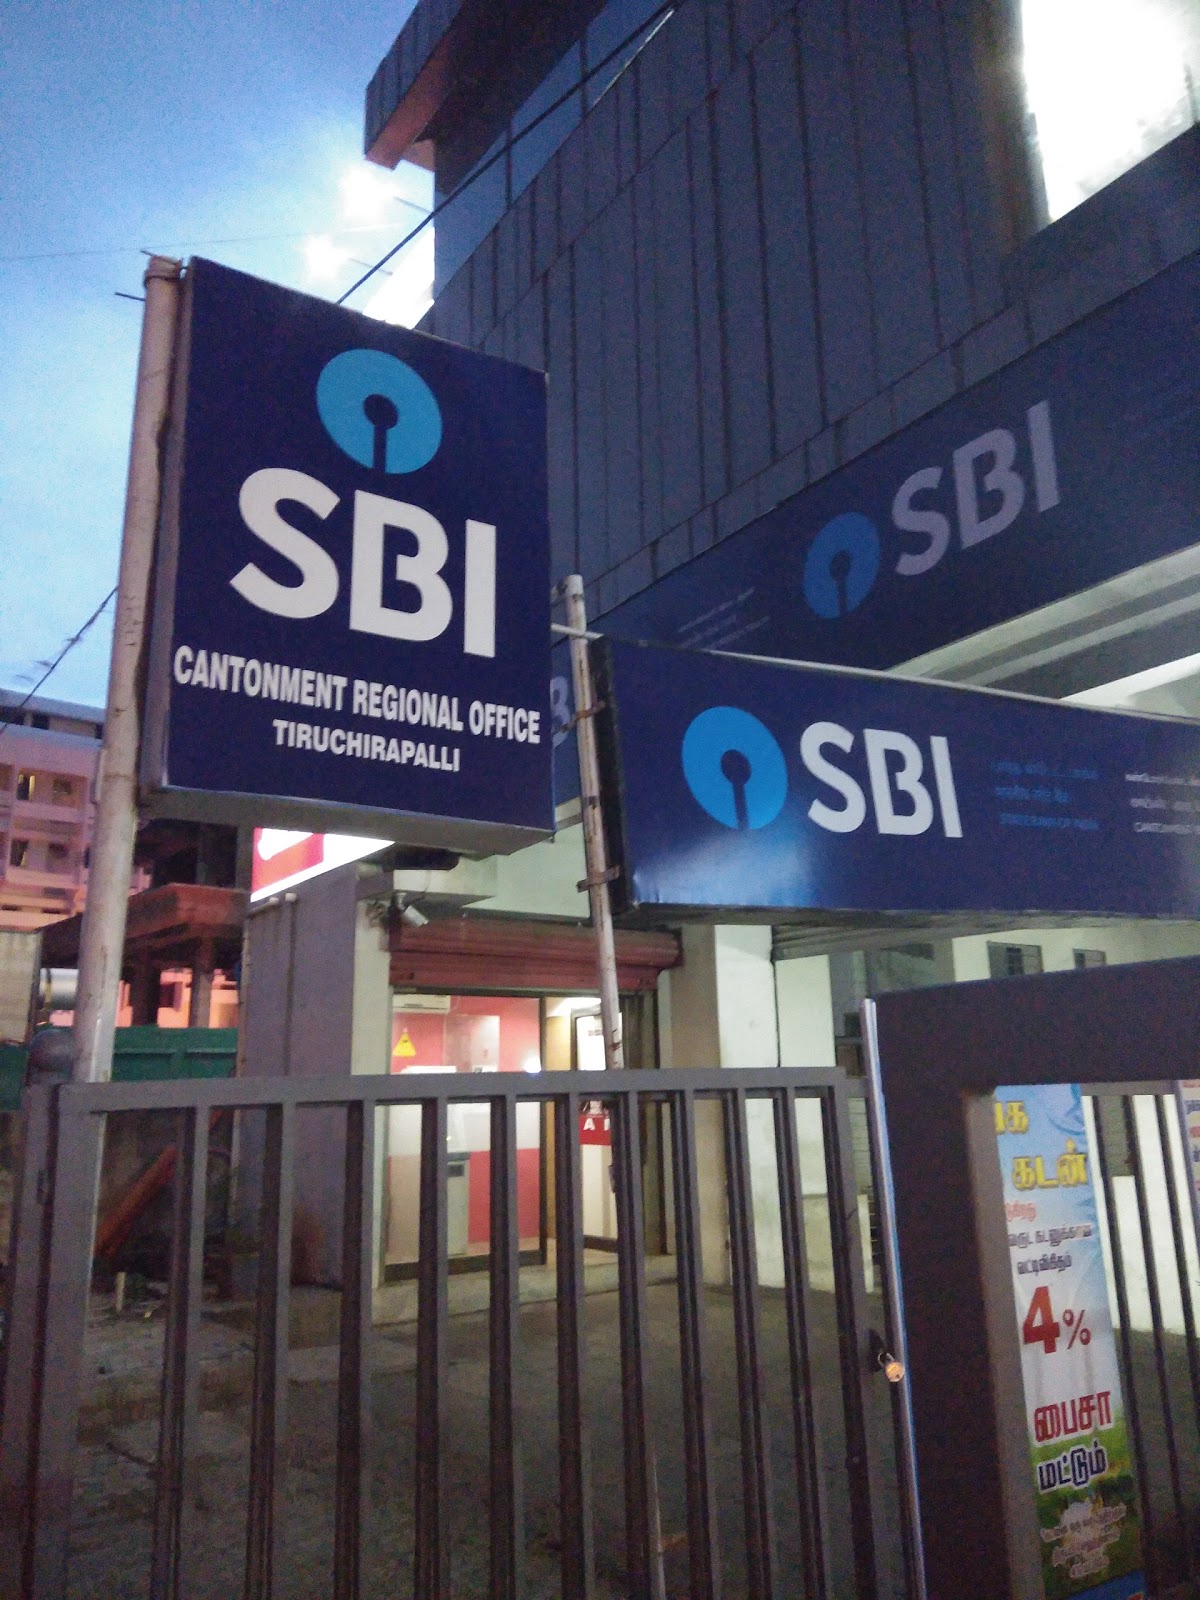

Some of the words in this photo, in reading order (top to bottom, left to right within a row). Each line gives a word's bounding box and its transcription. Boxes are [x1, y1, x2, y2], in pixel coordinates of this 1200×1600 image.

[892, 401, 1061, 576] SBI
[229, 467, 497, 658] SBI
[173, 645, 347, 712] CANTONMENT
[353, 680, 464, 732] REGIONAL
[468, 701, 541, 744] OFFICE
[272, 719, 461, 773] TIRUCHIRAPALLI
[800, 721, 963, 838] SBI
[1012, 1137, 1088, 1191] கடன்
[1033, 1390, 1113, 1443] பைசா
[1038, 1440, 1108, 1491] மட்டும்
